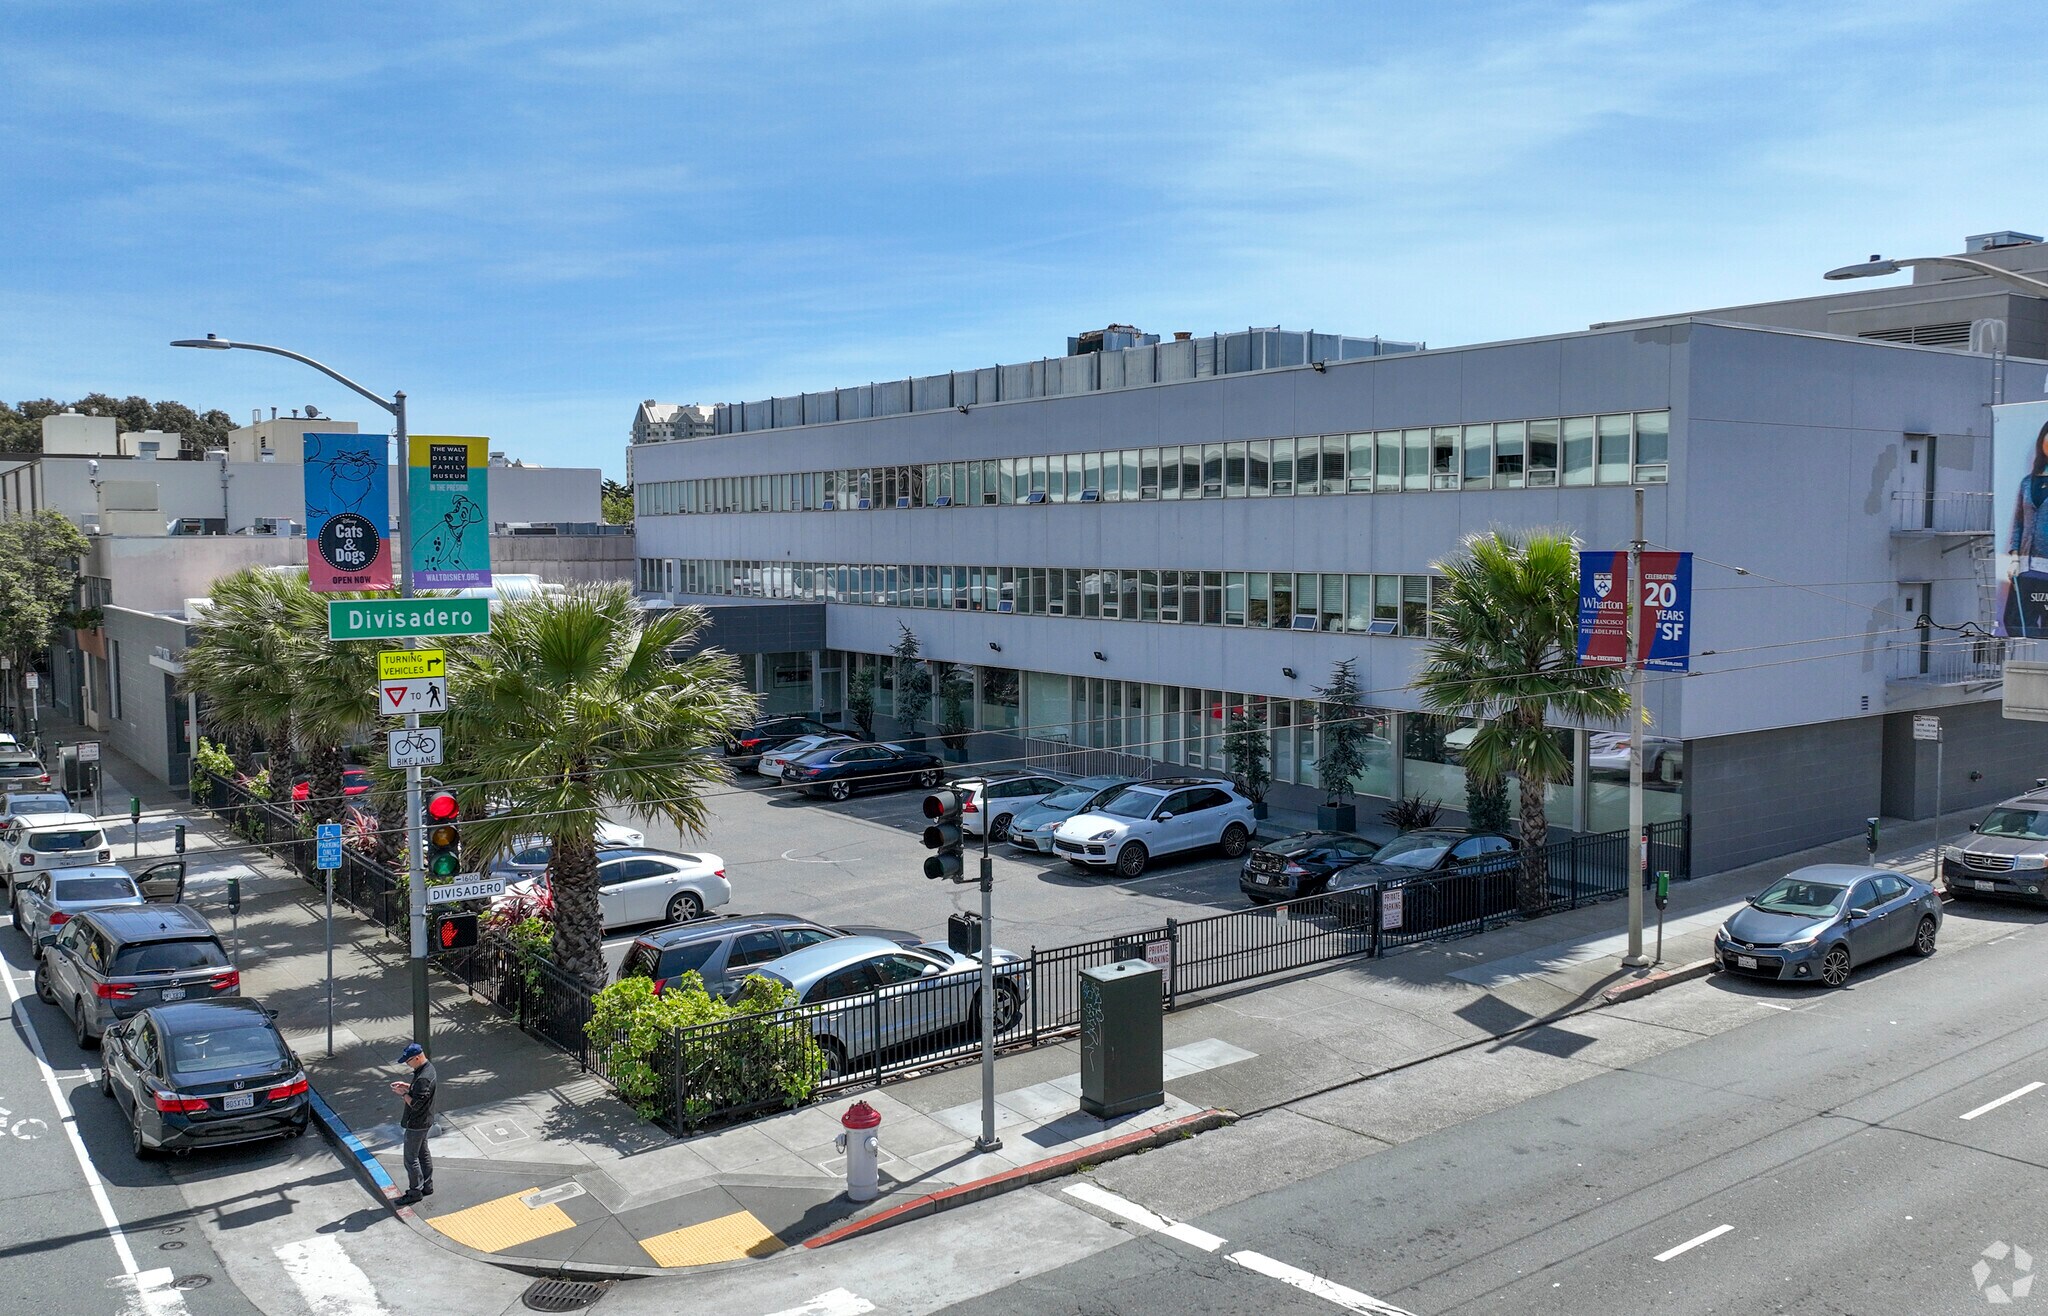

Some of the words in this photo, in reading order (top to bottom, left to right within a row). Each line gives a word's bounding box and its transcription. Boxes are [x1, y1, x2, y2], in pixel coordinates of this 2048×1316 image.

[335, 523, 364, 539] Cats
[343, 538, 357, 551] &
[335, 548, 366, 565] Dogs
[332, 576, 353, 585] OPEN
[354, 575, 372, 584] NOW
[425, 573, 480, 582] WALTDISNEY.ORG
[1644, 582, 1677, 608] 20
[1582, 597, 1623, 610] Wharton
[349, 608, 473, 631] Divisadero
[1656, 610, 1684, 621] YEARS
[1661, 622, 1684, 641] SF
[384, 654, 423, 664] TURNING
[384, 666, 425, 676] VEHICLES
[410, 692, 422, 700] TO
[396, 757, 413, 766] BIKE
[415, 755, 436, 766] LANE
[462, 874, 479, 882] 1600
[433, 882, 501, 900] DIVISADERO
[1148, 943, 1169, 956] PRIVATE
[1147, 953, 1170, 964] PARKING
